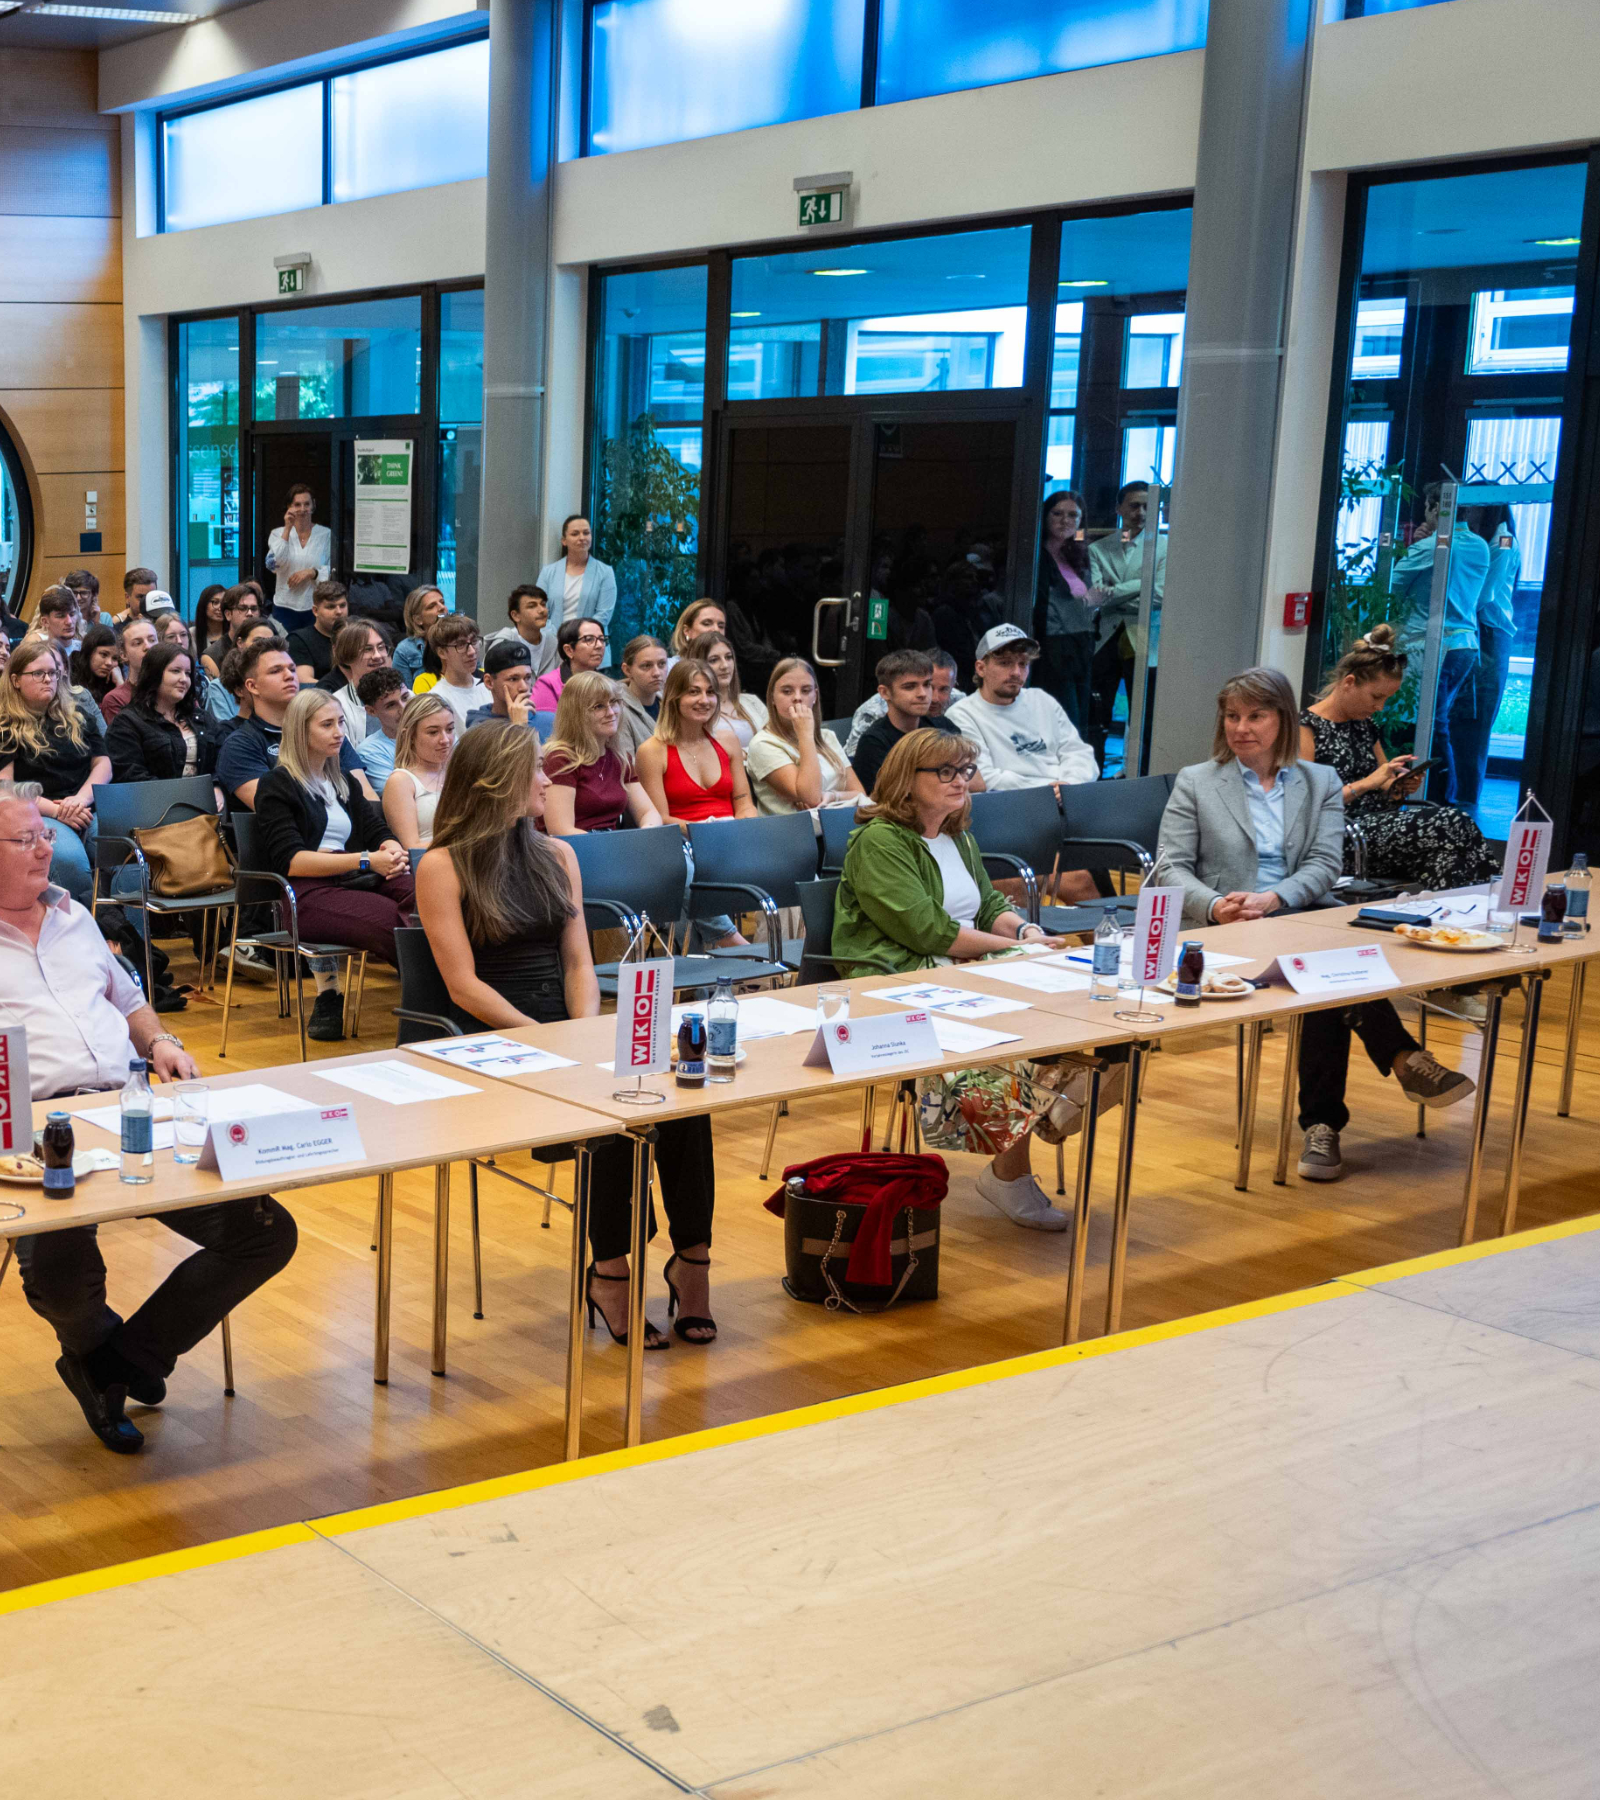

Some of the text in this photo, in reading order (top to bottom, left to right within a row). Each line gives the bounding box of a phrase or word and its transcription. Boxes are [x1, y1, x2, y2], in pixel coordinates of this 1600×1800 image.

[1511, 851, 1532, 905] WKO
[1145, 919, 1162, 978] WKO
[633, 997, 650, 1064] WKO
[321, 1109, 341, 1119] WKO
[258, 1145, 280, 1154] KommR
[296, 1141, 312, 1149] Carlo
[313, 1137, 333, 1146] EGGER
